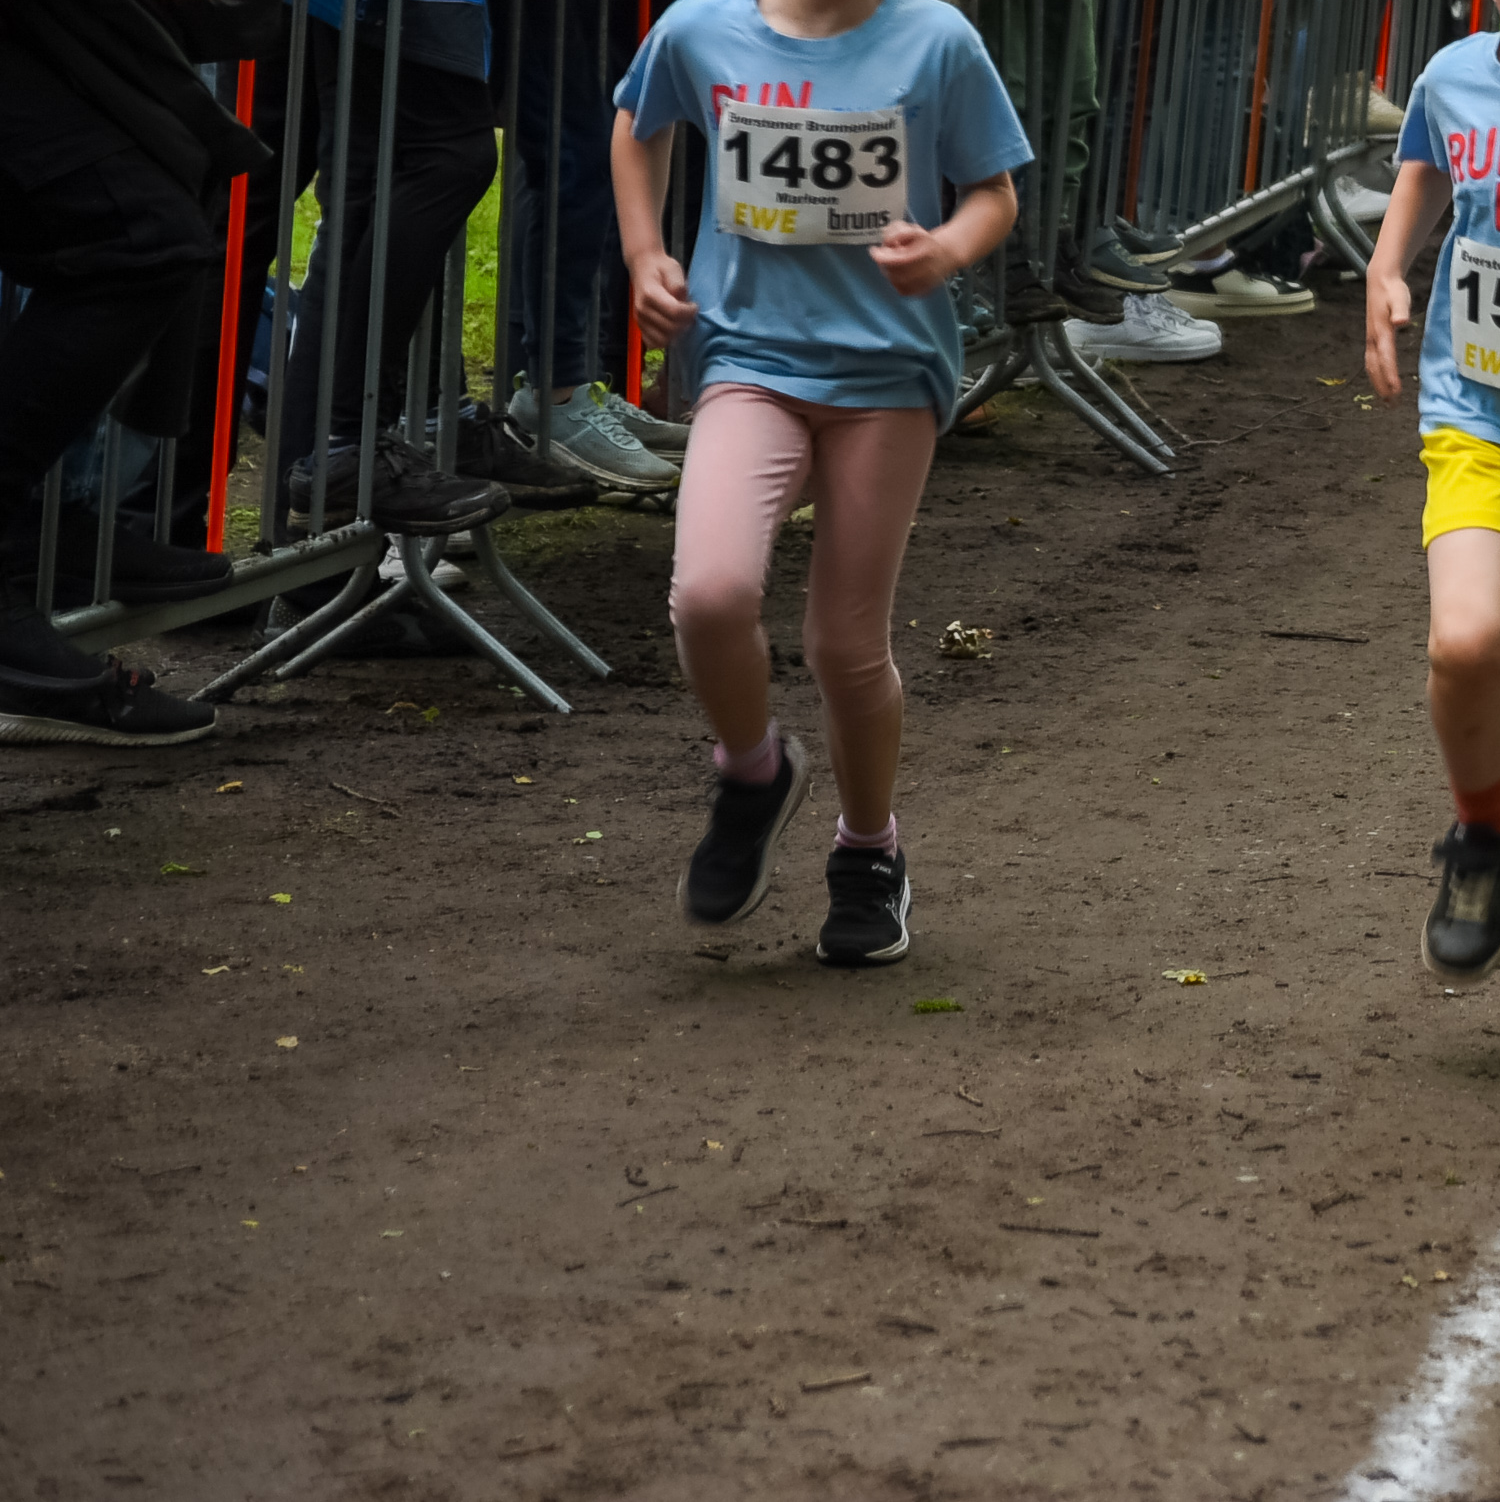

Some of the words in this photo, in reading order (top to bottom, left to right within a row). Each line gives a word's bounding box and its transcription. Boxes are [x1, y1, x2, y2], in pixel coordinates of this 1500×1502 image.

[724, 129, 902, 190] 1483
[734, 202, 798, 234] EWE
[827, 207, 891, 231] bruns
